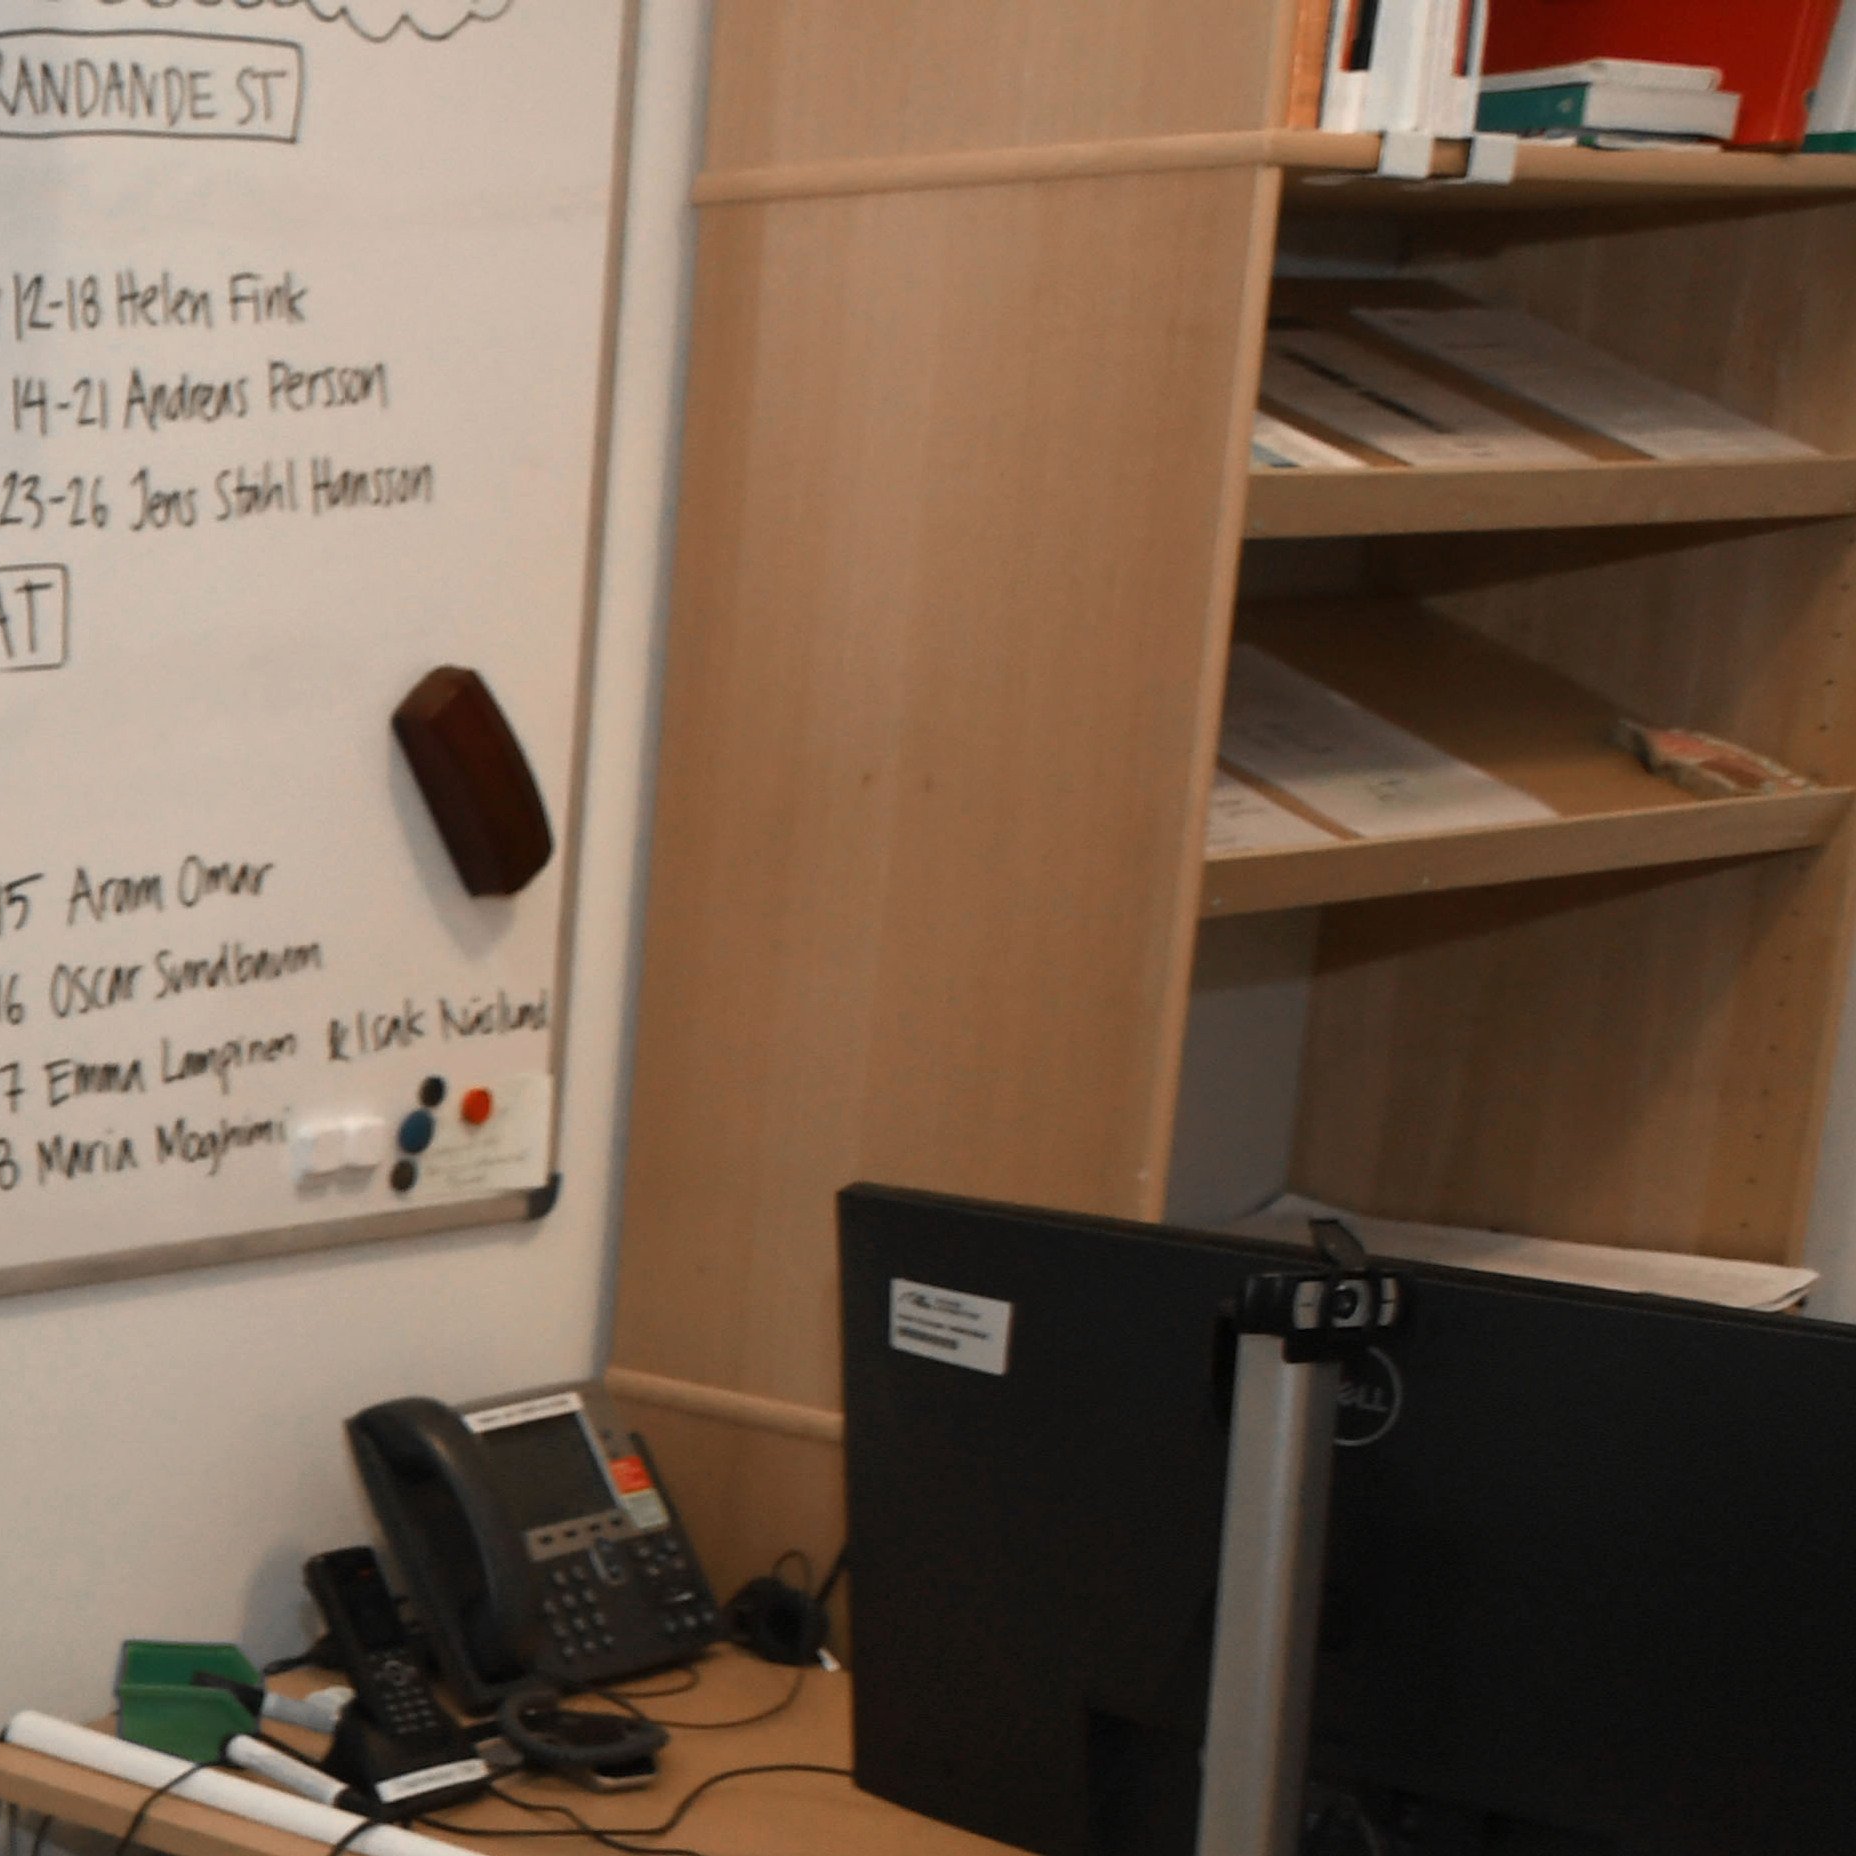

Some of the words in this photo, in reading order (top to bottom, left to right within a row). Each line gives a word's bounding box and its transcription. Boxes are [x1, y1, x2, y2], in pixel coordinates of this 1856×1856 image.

[236, 65, 288, 125] ST
[13, 273, 102, 341] 12-18
[114, 271, 214, 329] Helen
[228, 271, 309, 323] Fink
[122, 366, 249, 431] Andreas
[130, 466, 197, 531] Jens
[310, 454, 434, 516] Hansson
[66, 866, 165, 926] Aram
[177, 854, 274, 908] Omar
[49, 963, 144, 1019] Oscar
[43, 1057, 146, 1107] Emma
[36, 1127, 138, 1184] Maria
